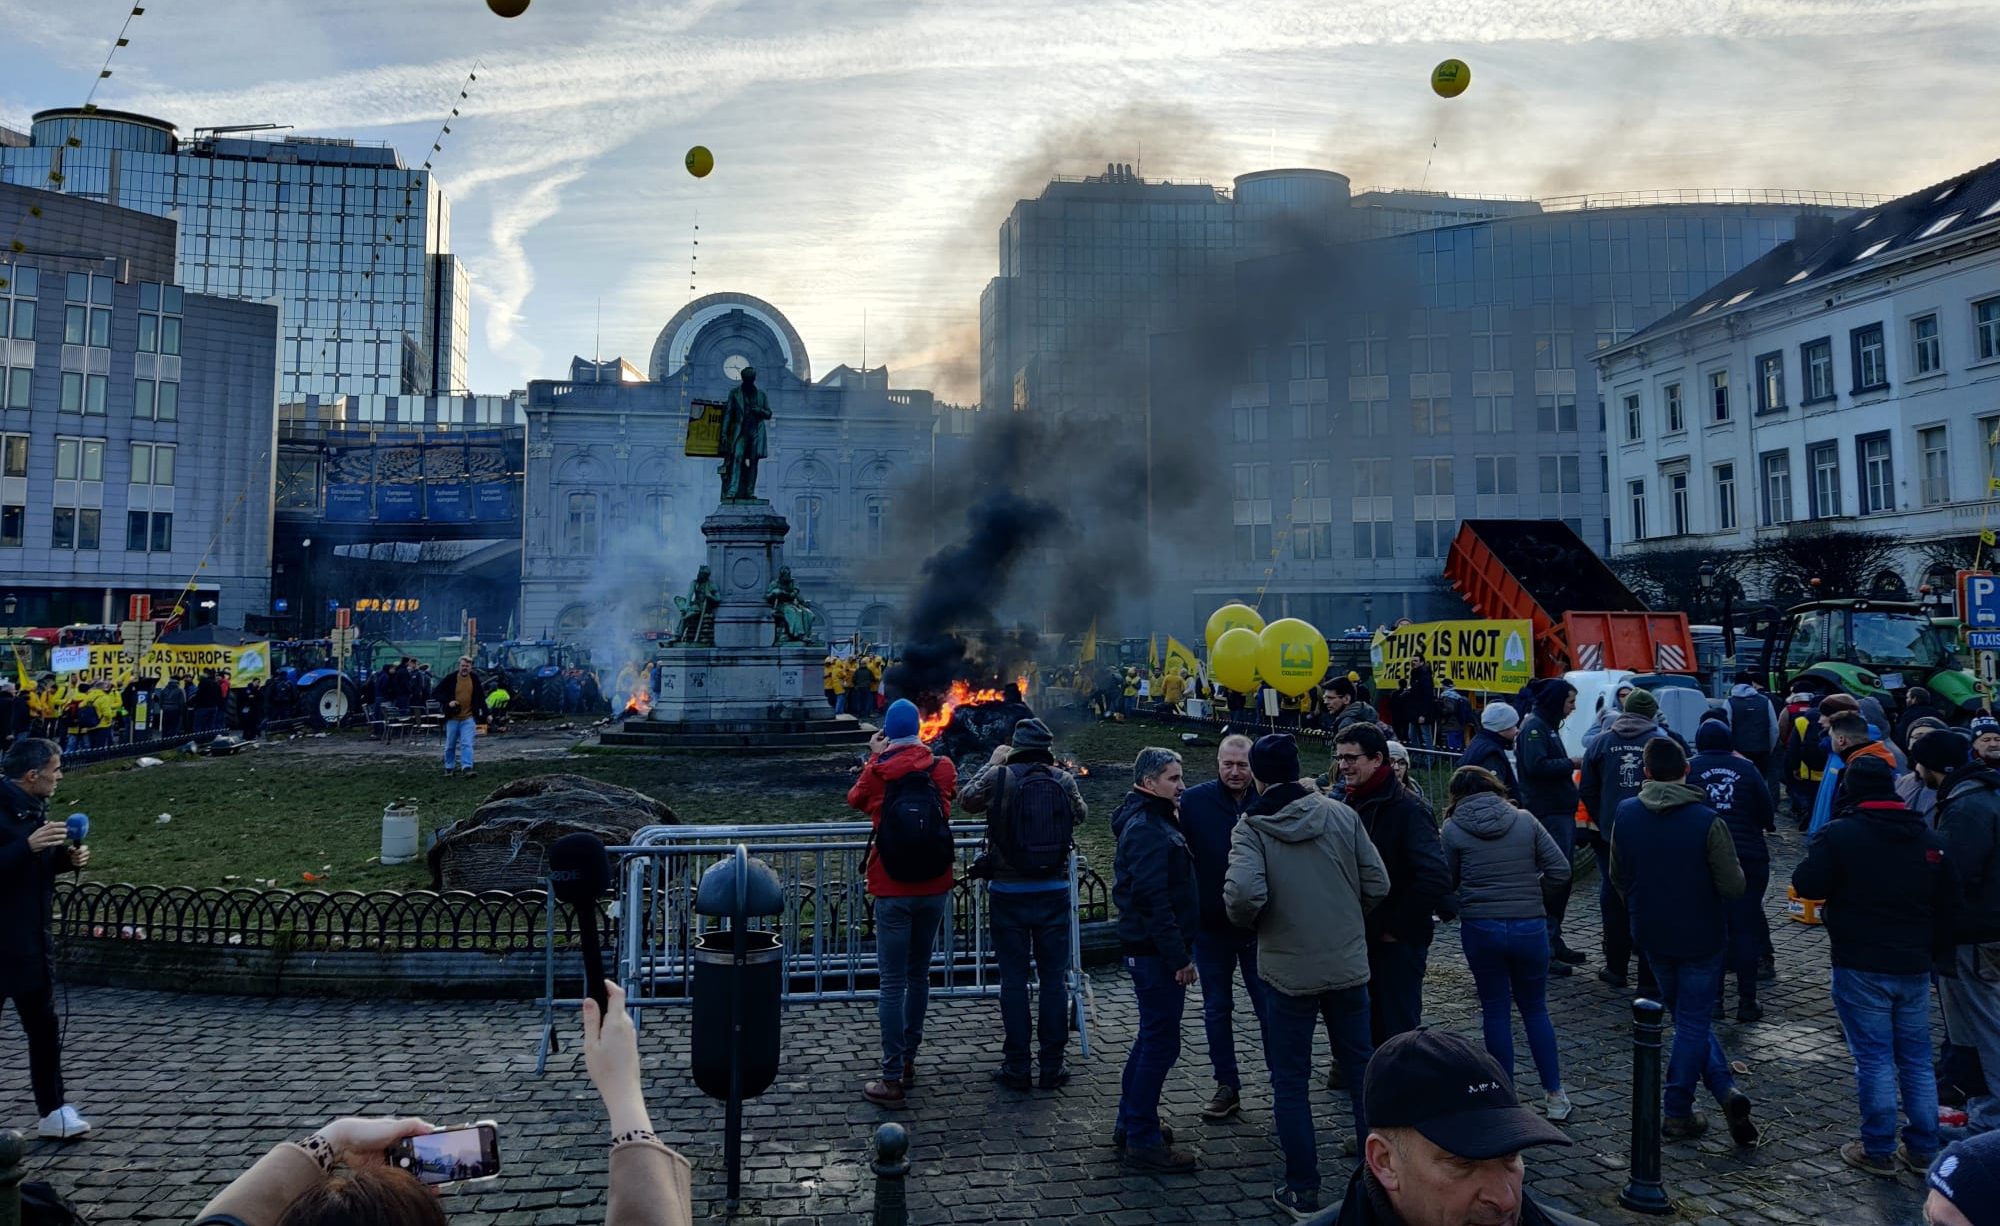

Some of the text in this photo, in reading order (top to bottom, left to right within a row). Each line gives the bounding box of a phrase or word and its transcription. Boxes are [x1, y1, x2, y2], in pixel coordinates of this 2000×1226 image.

[1974, 578, 1994, 606] P
[1386, 629, 1500, 659] THIS IS NOT
[1970, 633, 2000, 646] TAXIS
[103, 651, 135, 664] N'ES
[147, 650, 172, 664] PAS
[176, 650, 232, 664] L'EUROPE
[79, 667, 112, 681] QUE
[1383, 662, 1402, 680] THE
[1450, 661, 1465, 680] WE
[1467, 661, 1499, 681] WANT
